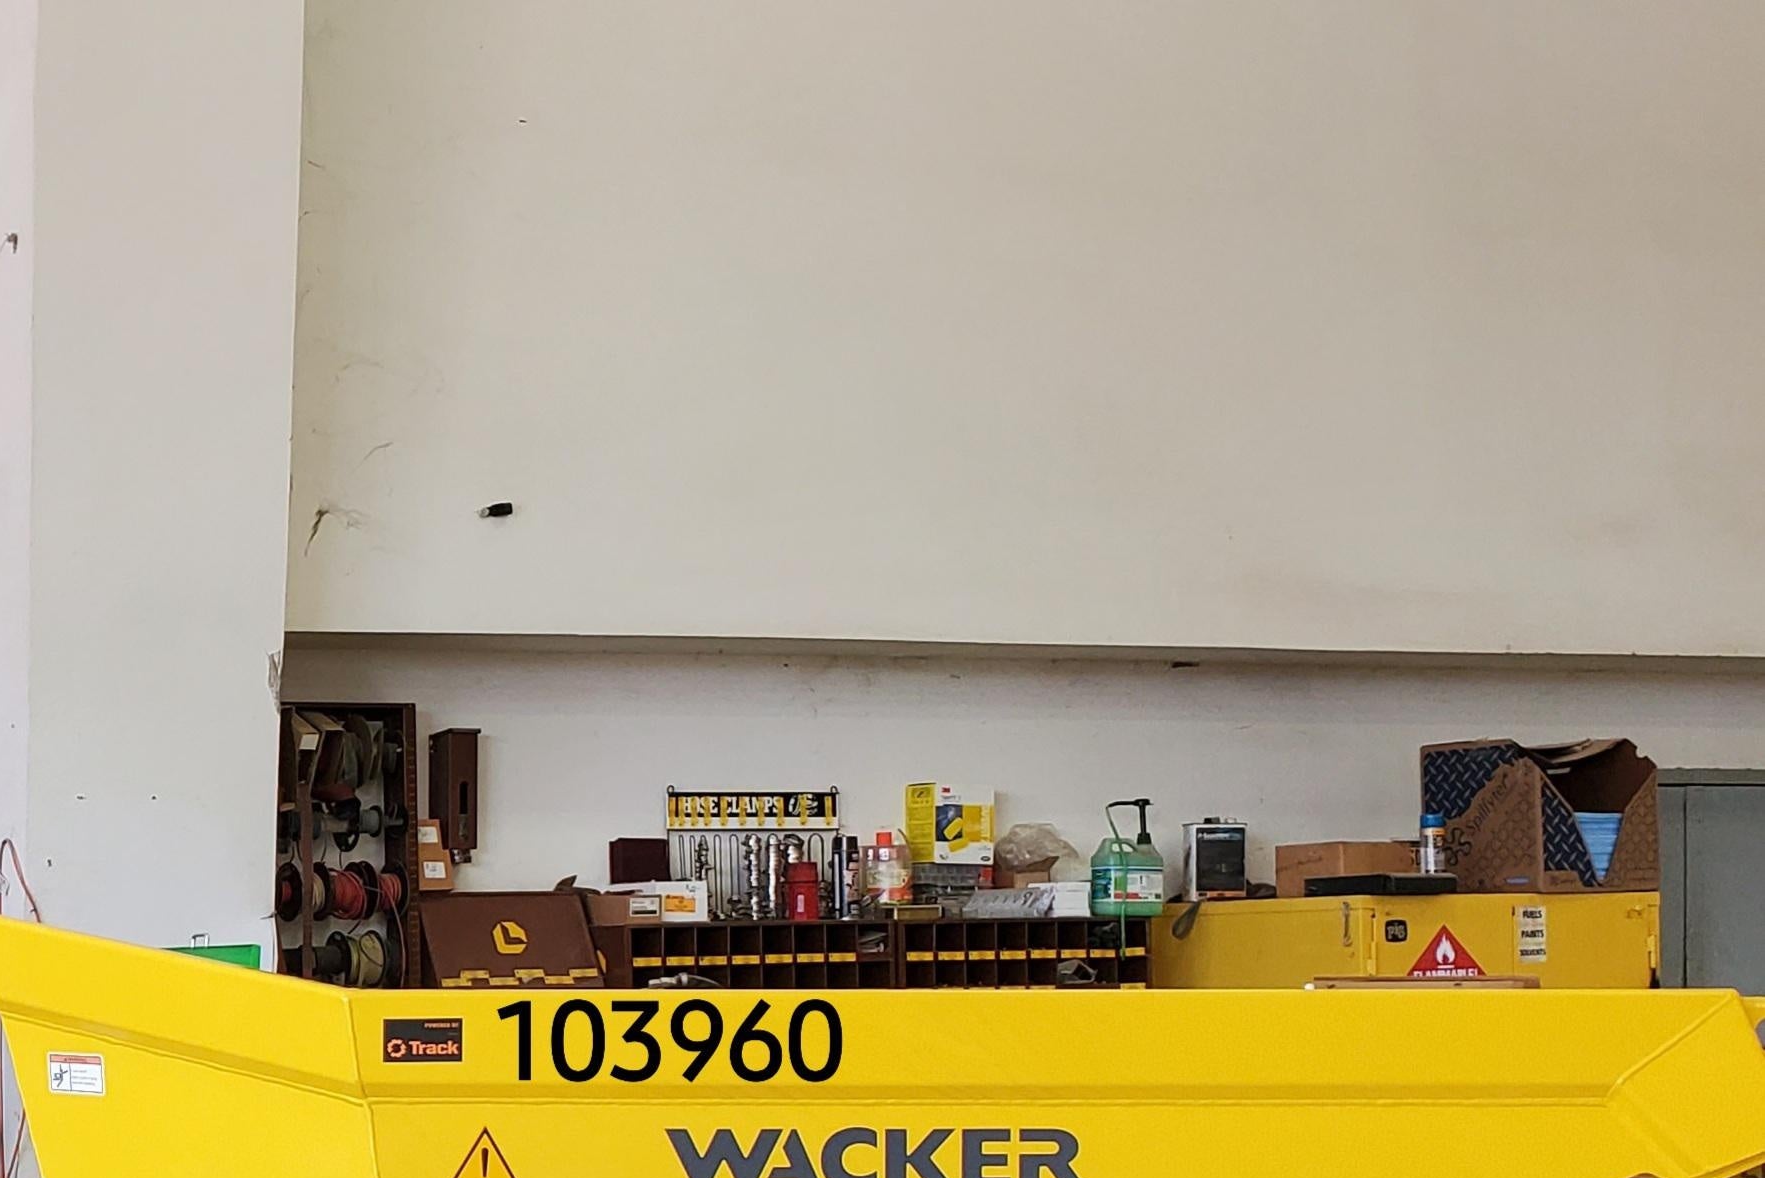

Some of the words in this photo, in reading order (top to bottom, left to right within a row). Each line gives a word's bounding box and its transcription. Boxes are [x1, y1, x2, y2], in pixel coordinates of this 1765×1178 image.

[683, 796, 718, 814] HSE
[408, 1040, 459, 1055] Track
[497, 998, 843, 1083] 103960
